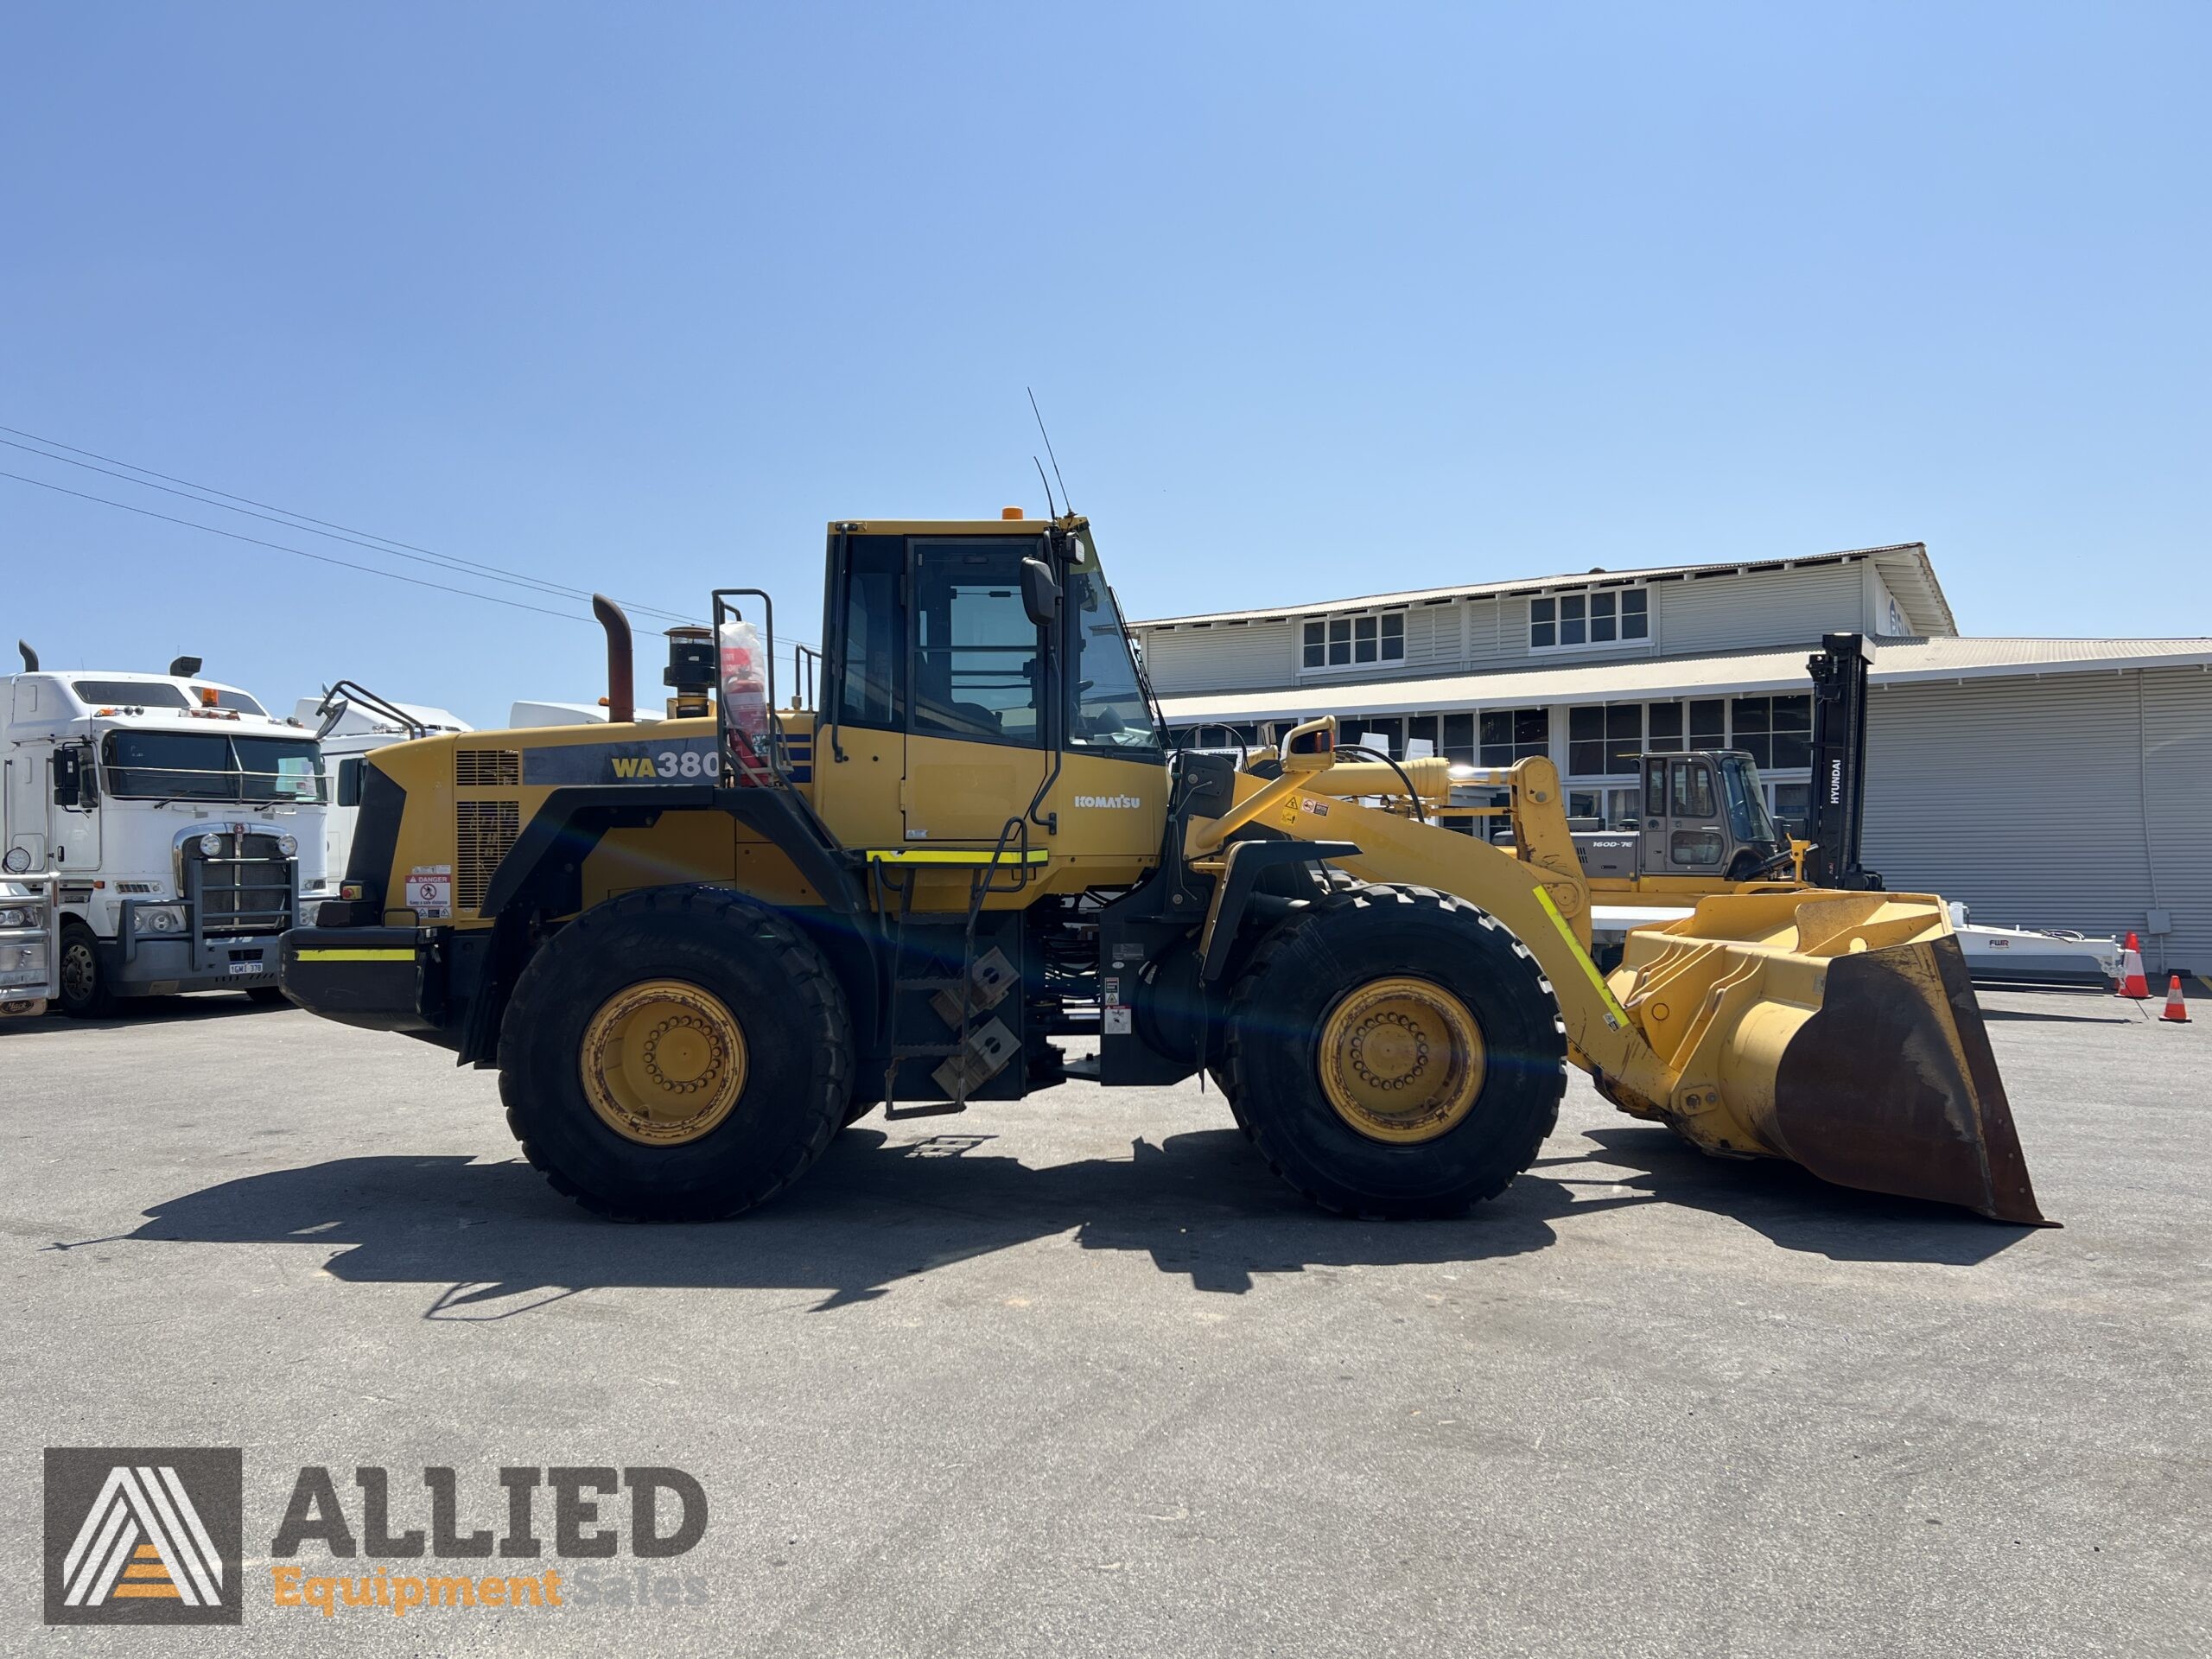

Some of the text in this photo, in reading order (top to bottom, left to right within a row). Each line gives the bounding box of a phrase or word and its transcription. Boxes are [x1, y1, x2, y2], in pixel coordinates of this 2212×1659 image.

[612, 751, 720, 778] WA380
[1830, 760, 1840, 804] HYUNDAI
[1074, 794, 1141, 809] KOMATSU
